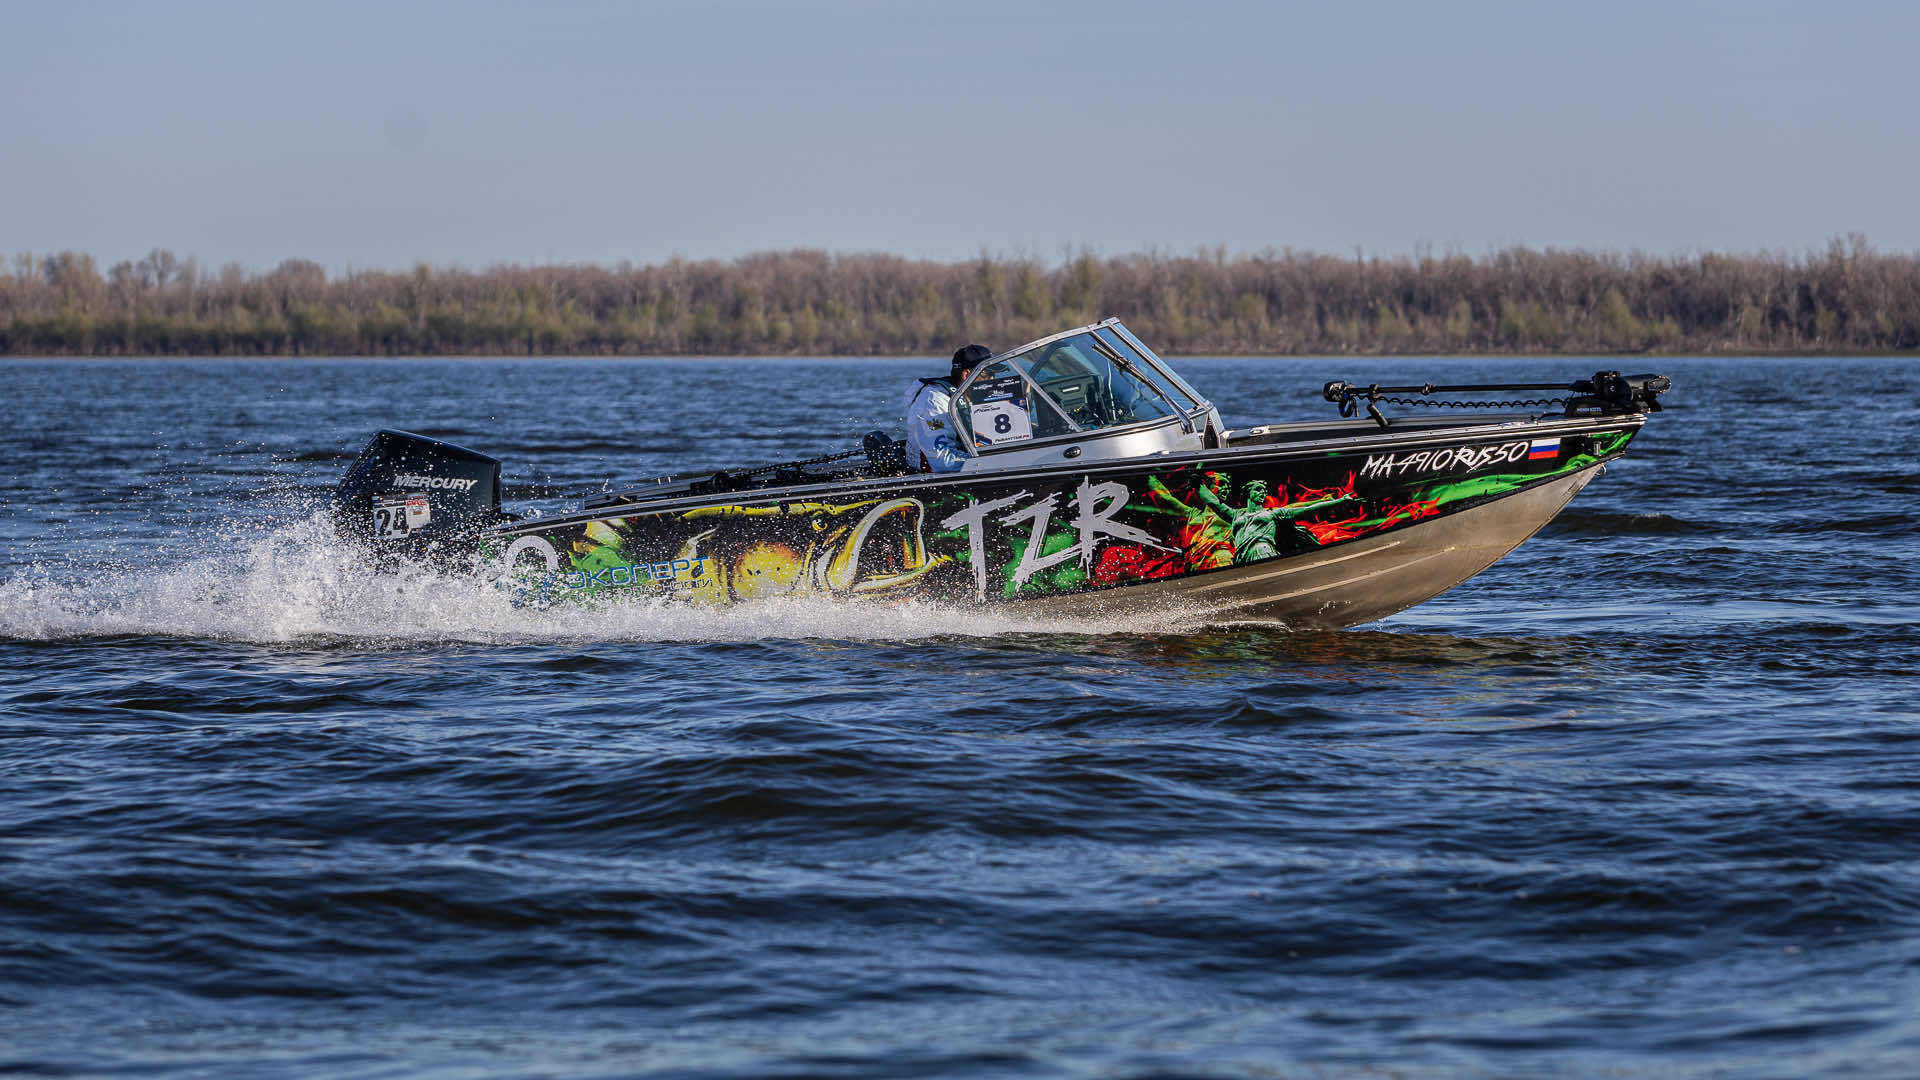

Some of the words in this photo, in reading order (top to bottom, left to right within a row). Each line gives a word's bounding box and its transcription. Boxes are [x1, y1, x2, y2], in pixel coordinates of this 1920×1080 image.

[994, 413, 1012, 434] 8
[393, 475, 478, 490] MERCURY
[940, 475, 1182, 603] TZR
[566, 556, 709, 590] ЭКСПЕРТ
